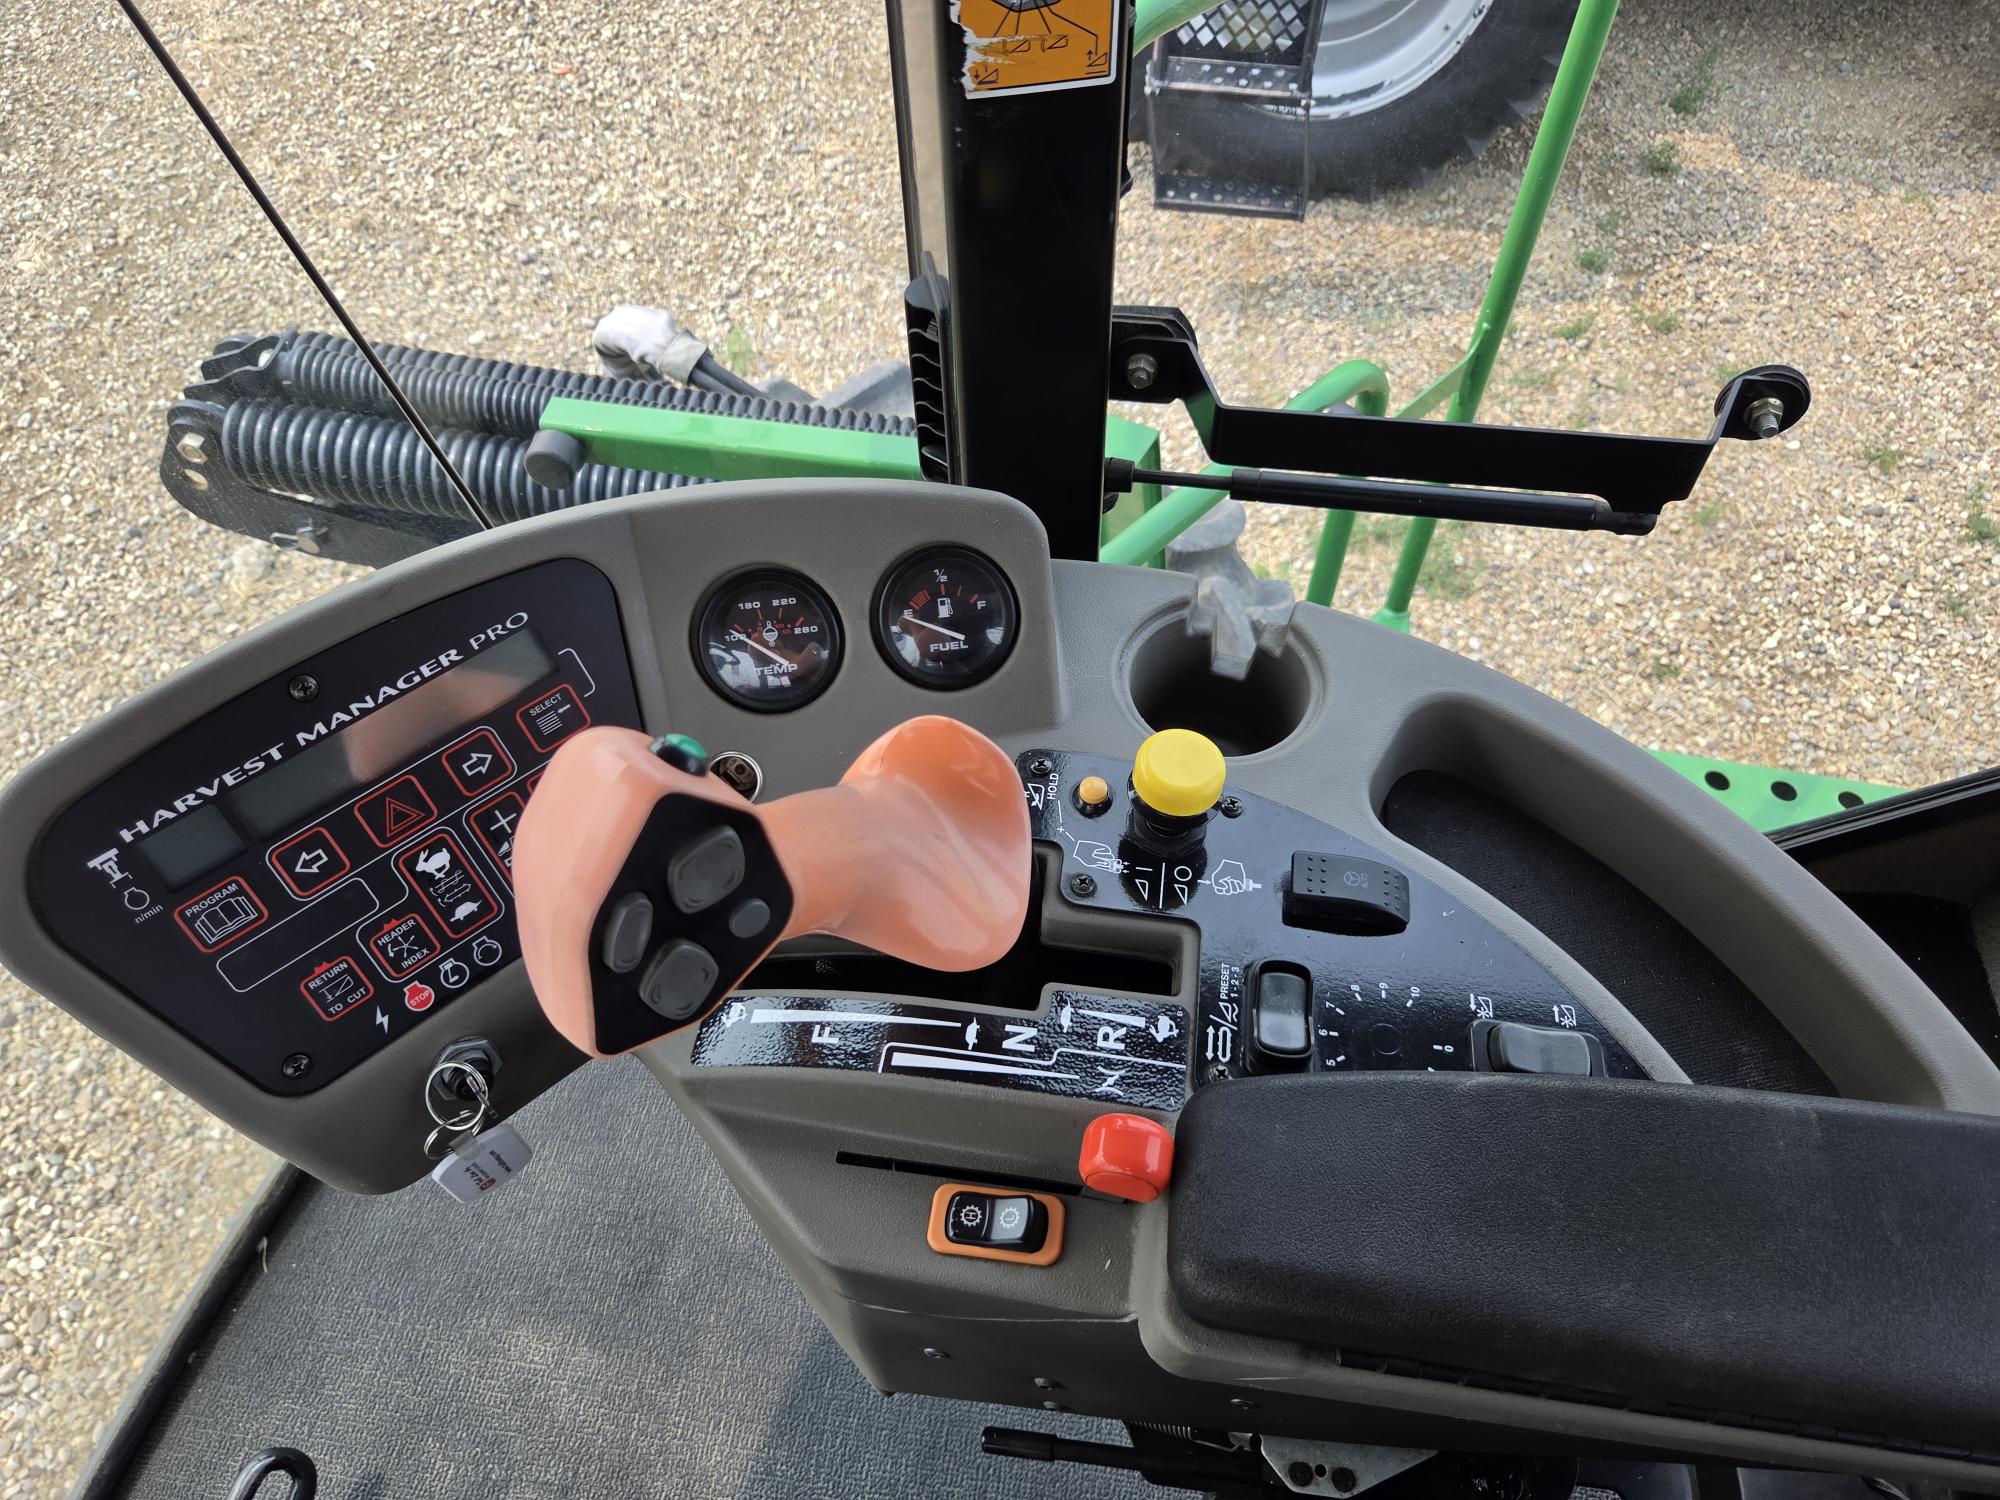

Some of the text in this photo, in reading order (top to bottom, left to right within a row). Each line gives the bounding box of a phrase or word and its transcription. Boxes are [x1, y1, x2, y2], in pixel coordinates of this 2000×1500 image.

[738, 601, 760, 610] 180
[772, 597, 797, 606] 220
[976, 600, 987, 609] F
[903, 608, 914, 617] E
[930, 640, 968, 652] FUEL
[754, 663, 798, 676] TEMP
[529, 693, 563, 717] SELECT
[119, 611, 529, 843] HARVEST MANAGER PRO
[1046, 773, 1059, 800] HOLD
[184, 883, 239, 917] PROGRAM
[134, 904, 164, 924] n/min
[377, 919, 416, 947] HEADER
[401, 947, 430, 969] INDEX
[308, 961, 349, 989] RETURN
[1219, 962, 1230, 1000] PRESET
[328, 987, 367, 1015] TO CUT
[409, 989, 431, 1007] STOP
[1410, 986, 1420, 998] 10
[1326, 1001, 1335, 1009] 7
[811, 1025, 840, 1044] F
[1002, 1024, 1038, 1052] N
[1096, 1025, 1127, 1050] R
[1326, 1059, 1336, 1067] 5
